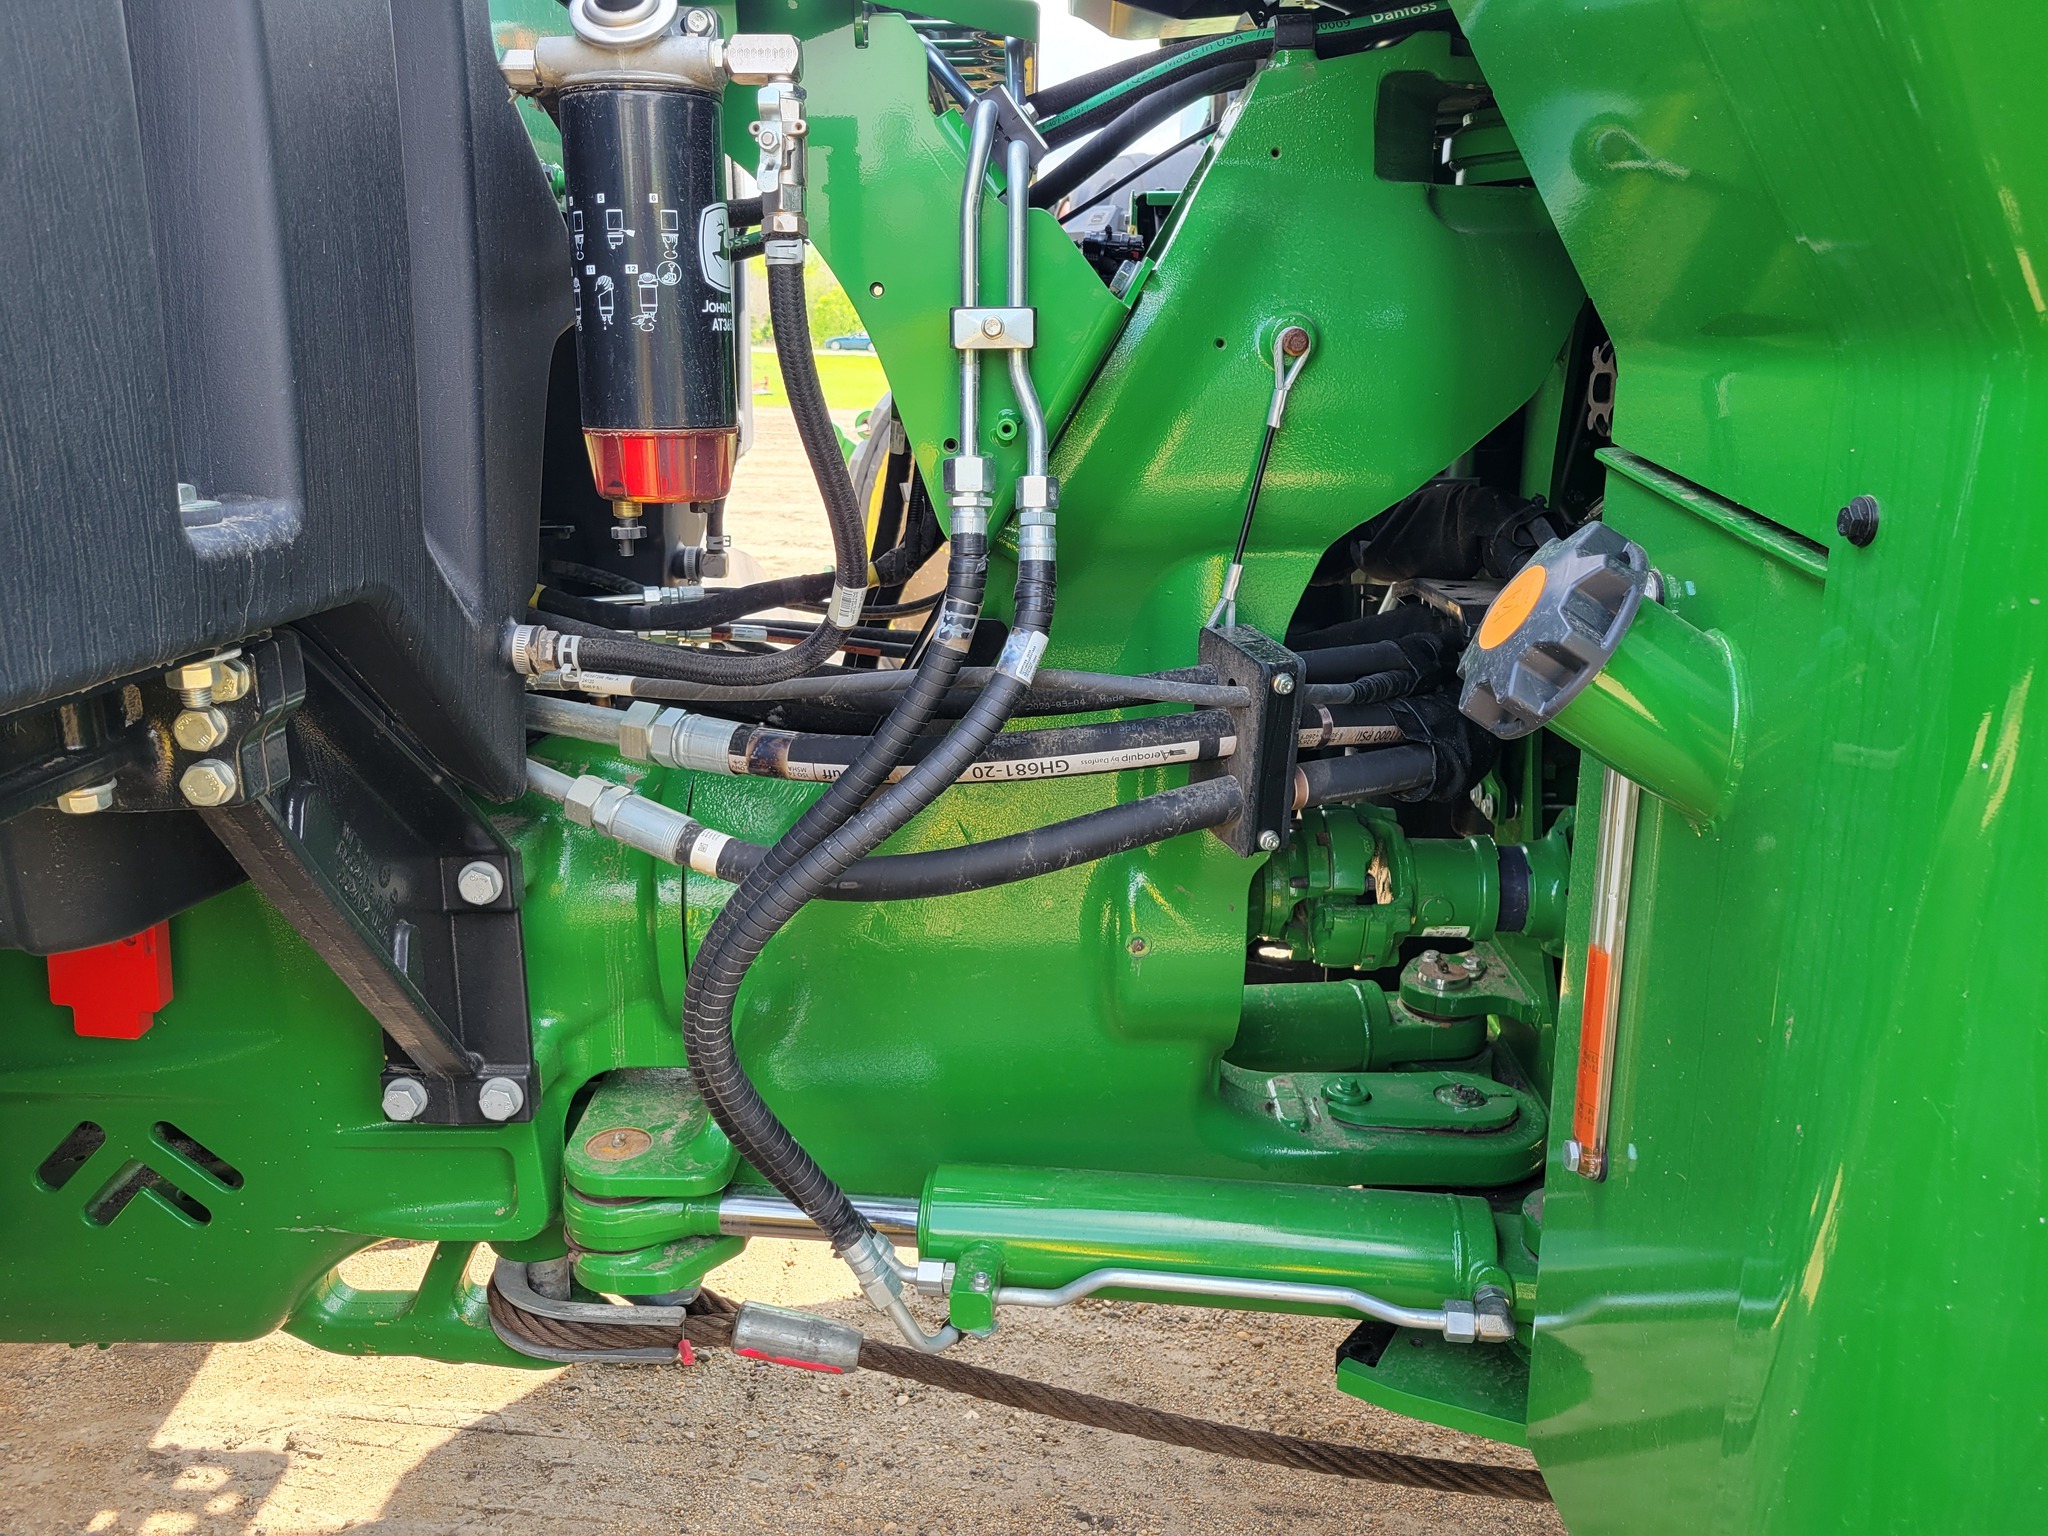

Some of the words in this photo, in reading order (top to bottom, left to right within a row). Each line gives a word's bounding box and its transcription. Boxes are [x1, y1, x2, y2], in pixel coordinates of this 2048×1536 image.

[1371, 2, 1438, 23] Danfoss
[1217, 35, 1244, 50] USA
[701, 299, 727, 313] JOHN
[1098, 693, 1125, 704] Made
[1119, 722, 1144, 734] Made
[1080, 757, 1109, 767] Danfoss
[1109, 755, 1120, 763] by
[822, 768, 841, 780] uff
[972, 759, 1069, 779] GH681-20
